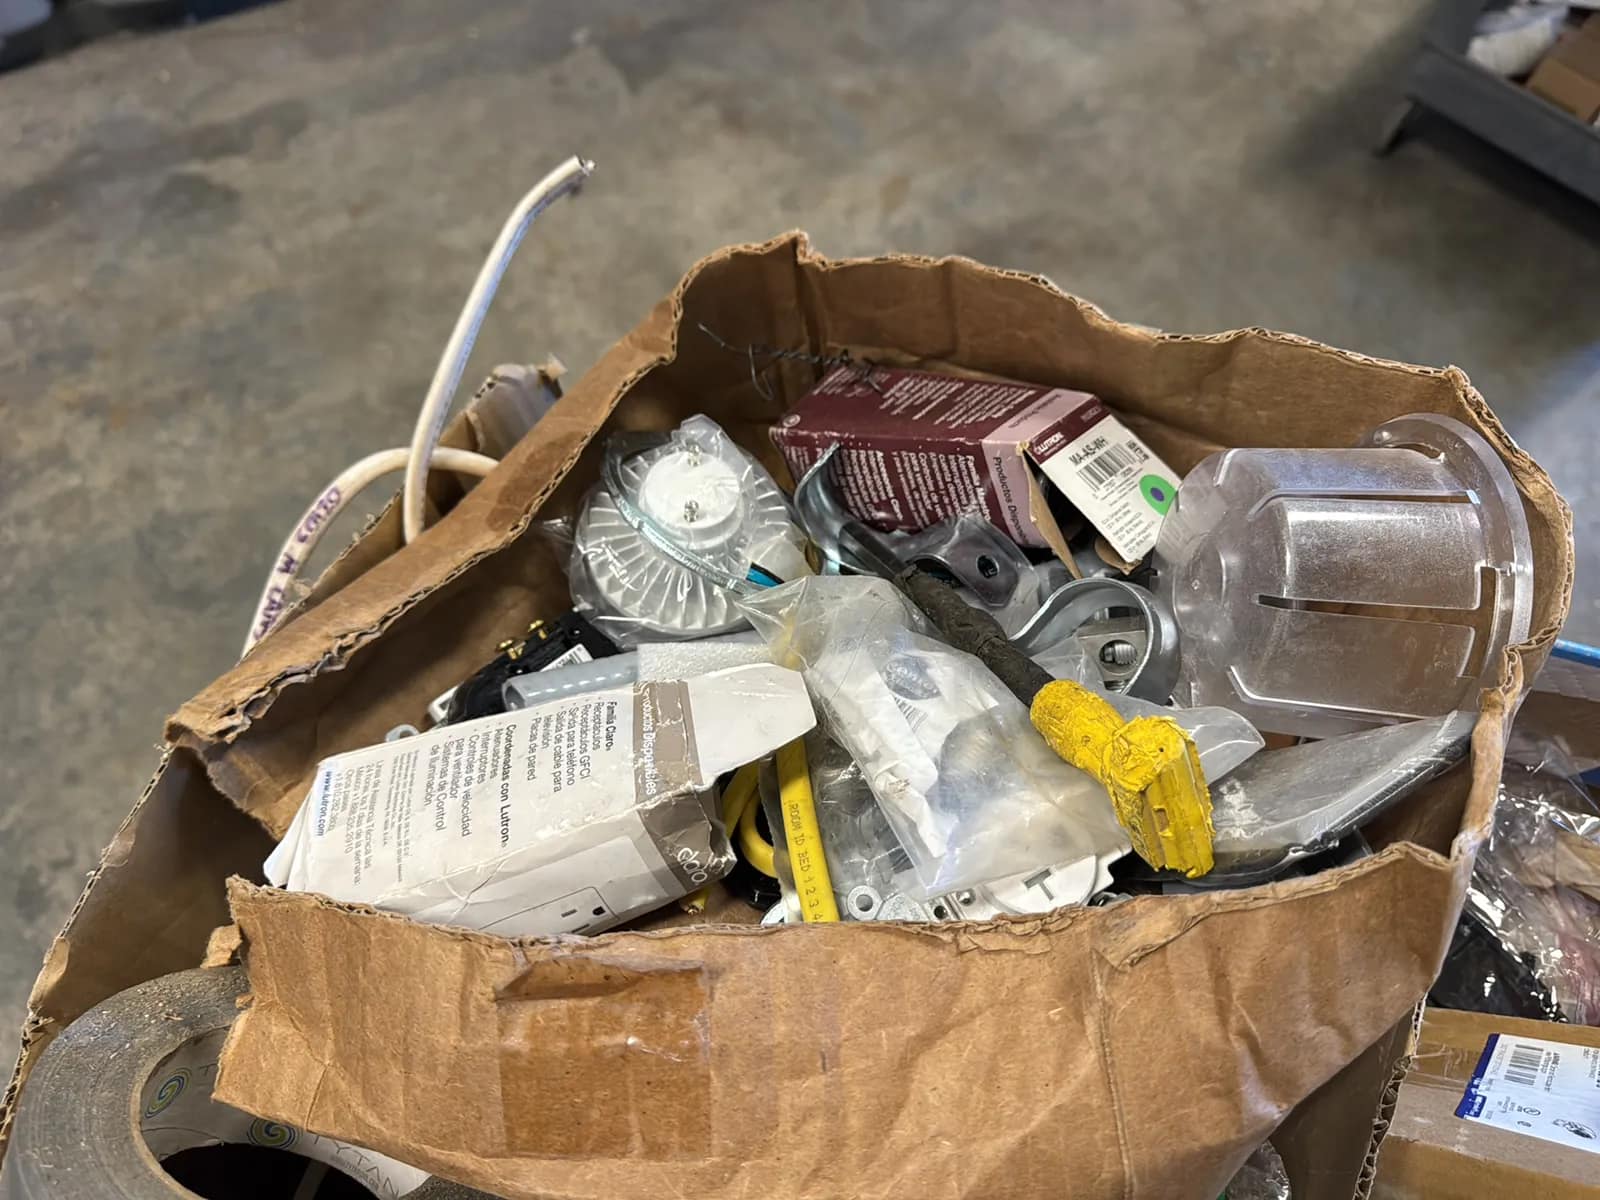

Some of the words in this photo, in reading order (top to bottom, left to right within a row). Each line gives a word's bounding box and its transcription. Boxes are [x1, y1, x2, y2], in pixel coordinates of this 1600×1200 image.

[993, 456, 1012, 503] Productos
[555, 710, 567, 733] Salida
[606, 702, 618, 725] Familia
[430, 744, 441, 756] de
[455, 738, 466, 757] para
[528, 743, 540, 754] de
[554, 734, 564, 745] de
[565, 730, 576, 749] para
[440, 741, 456, 779] Sistemas
[465, 734, 480, 775] Controles
[502, 724, 517, 781] Coordenadas
[553, 746, 564, 769] cable
[449, 758, 464, 800] ventilador
[527, 755, 538, 781] pared
[566, 750, 578, 786] teléfono
[579, 755, 592, 780] GFCI
[438, 780, 449, 791] de
[463, 776, 475, 788] de
[500, 782, 510, 802] con
[552, 771, 563, 792] para
[317, 771, 333, 837] www.lutron.com
[435, 793, 448, 832] Control
[461, 790, 473, 838] velocidad
[796, 850, 811, 872] BED
